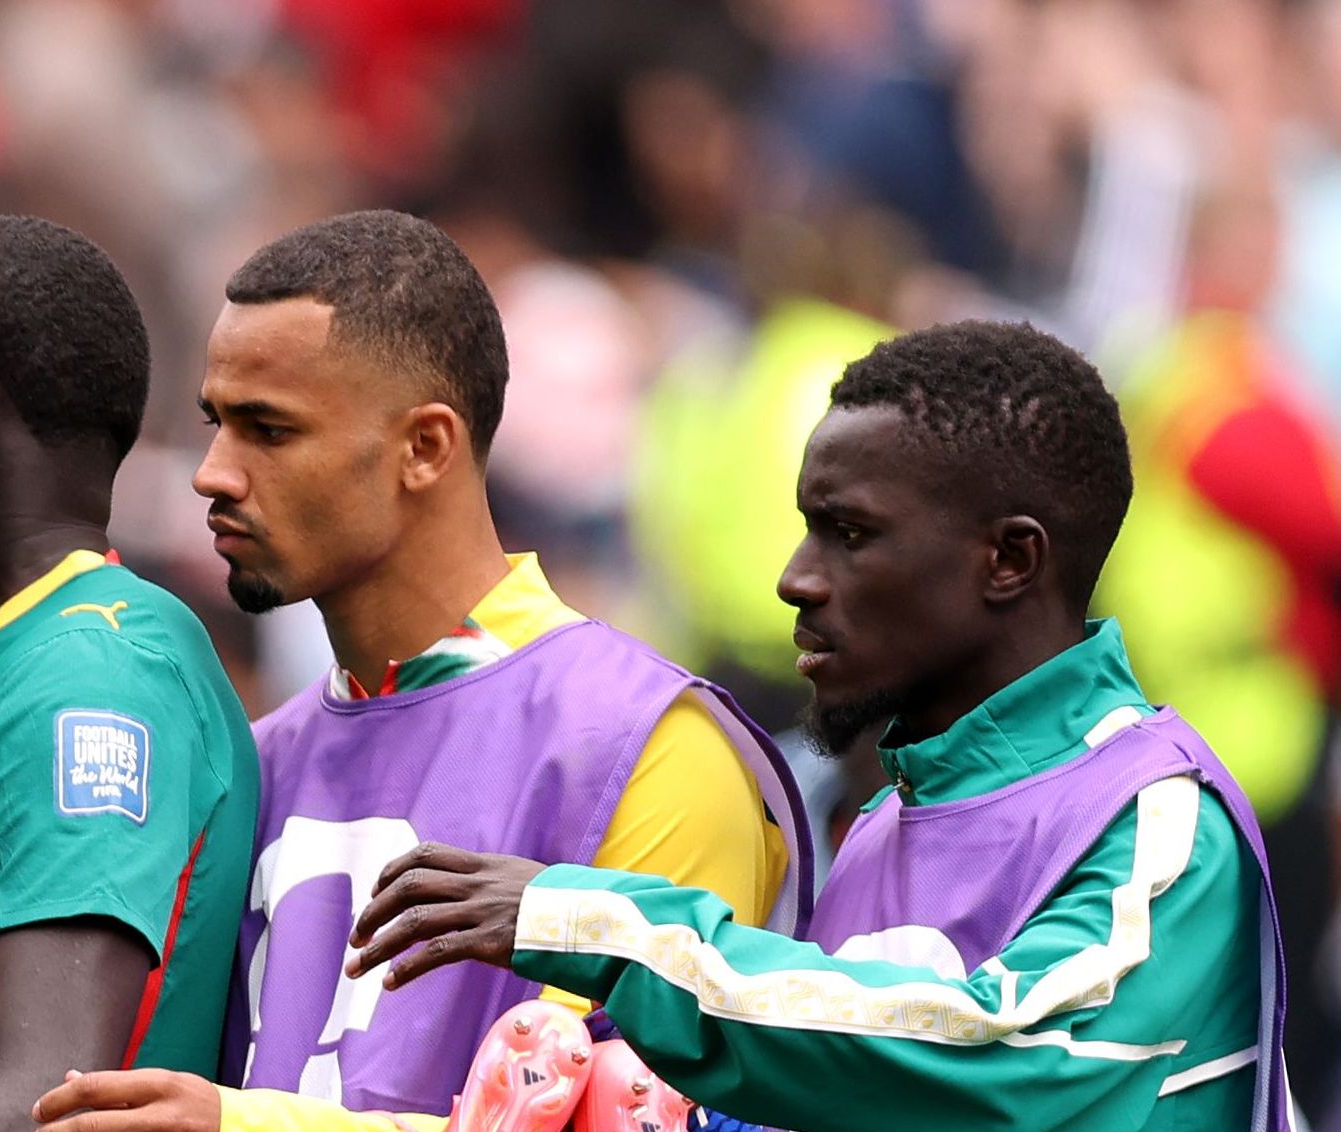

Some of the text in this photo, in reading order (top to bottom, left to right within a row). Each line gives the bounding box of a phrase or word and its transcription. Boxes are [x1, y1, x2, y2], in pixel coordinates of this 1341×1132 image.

[74, 725, 136, 750] FOOTBALL
[74, 740, 138, 774] UNITES
[69, 764, 98, 785] the
